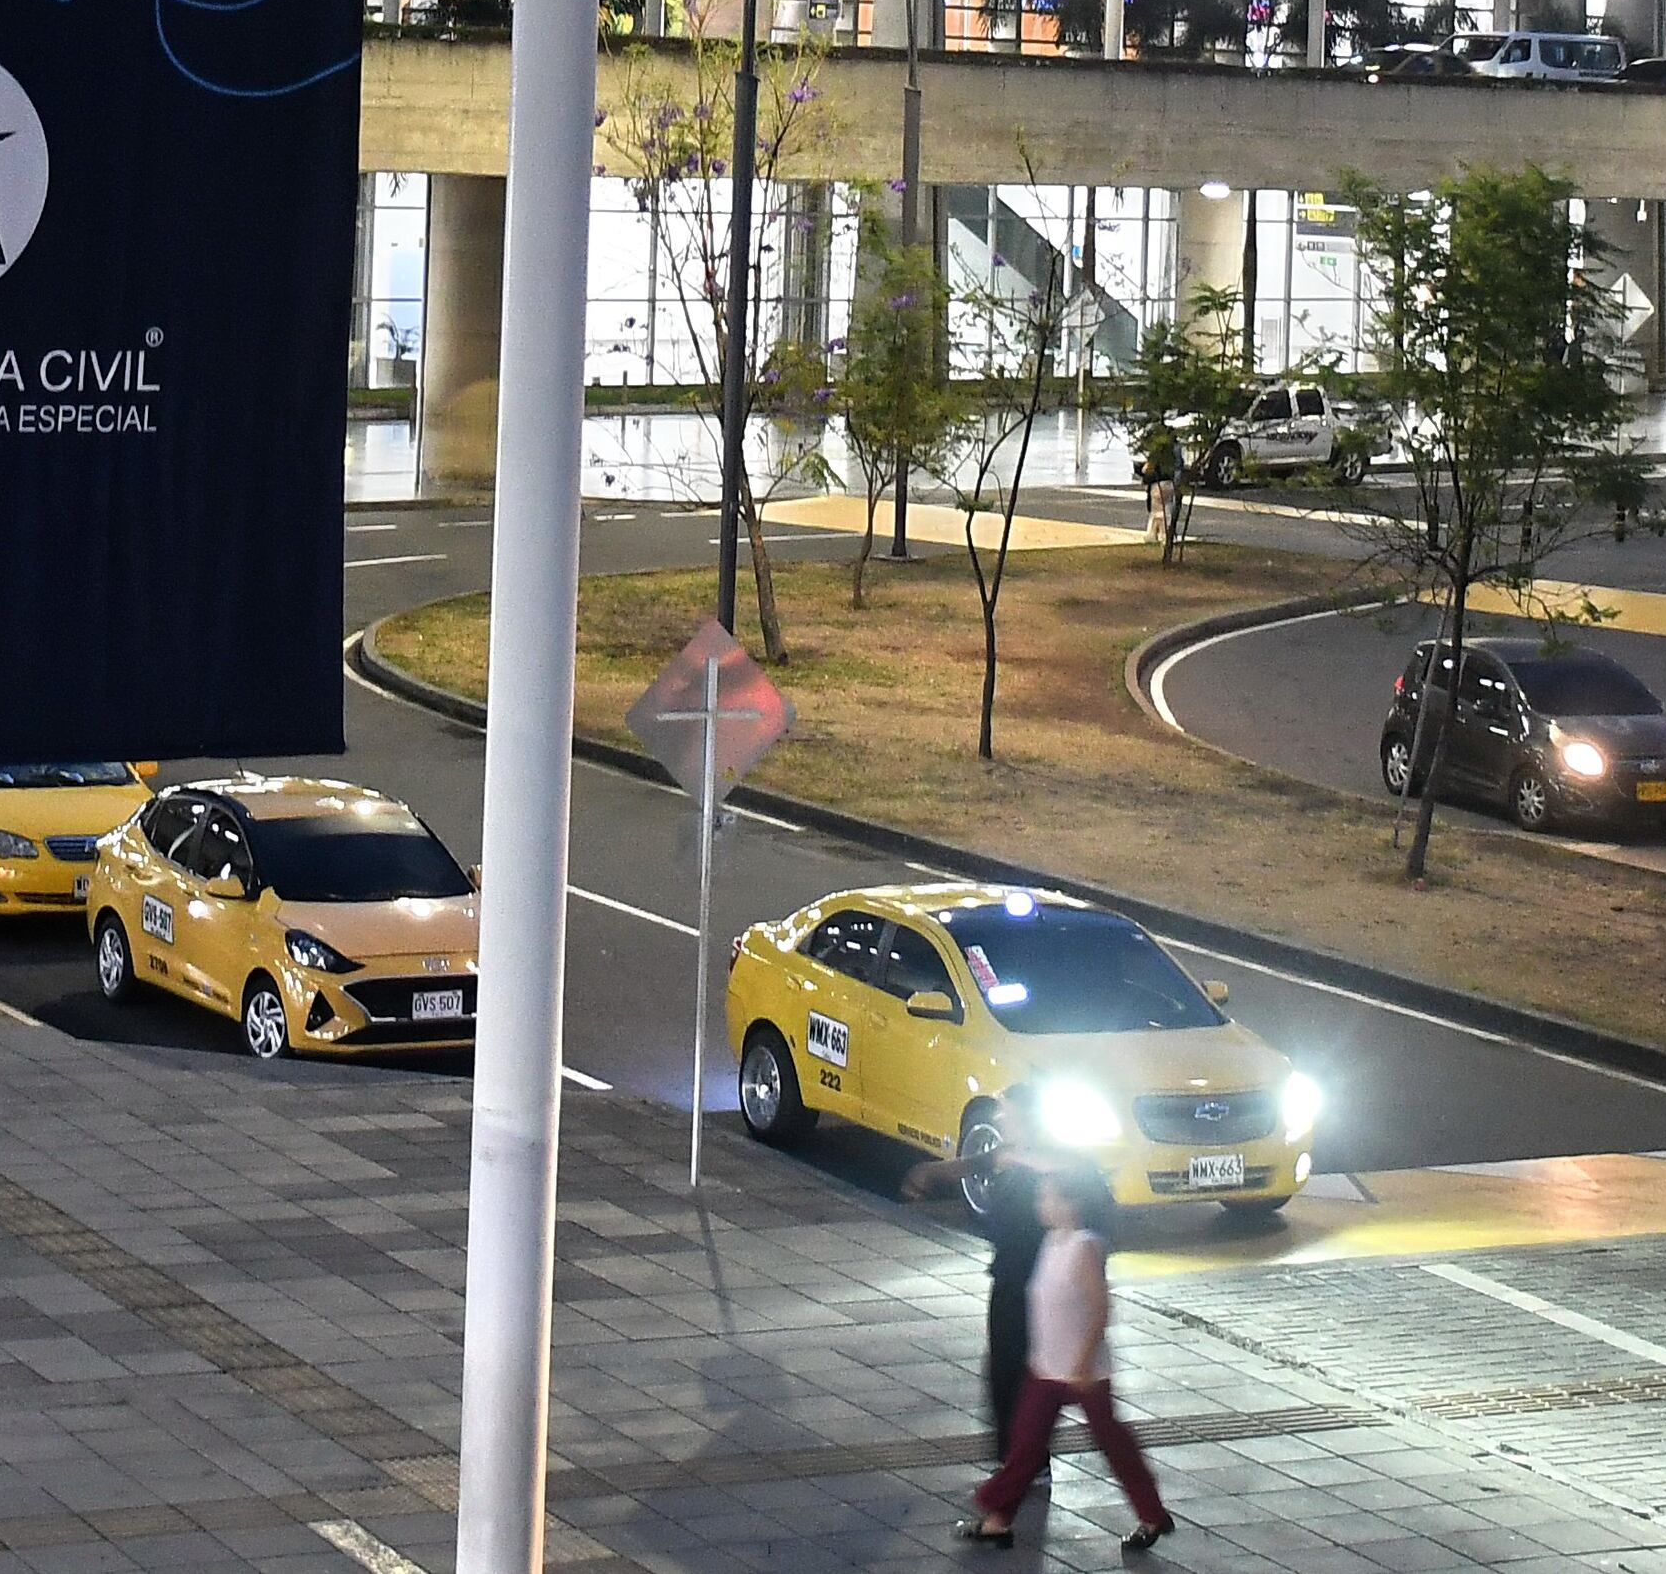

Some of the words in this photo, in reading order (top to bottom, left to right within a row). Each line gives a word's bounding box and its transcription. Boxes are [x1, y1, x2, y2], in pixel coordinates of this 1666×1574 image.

[39, 348, 161, 392] CIVIL
[18, 404, 157, 434] ESPECIAL
[819, 1068, 842, 1092] 222
